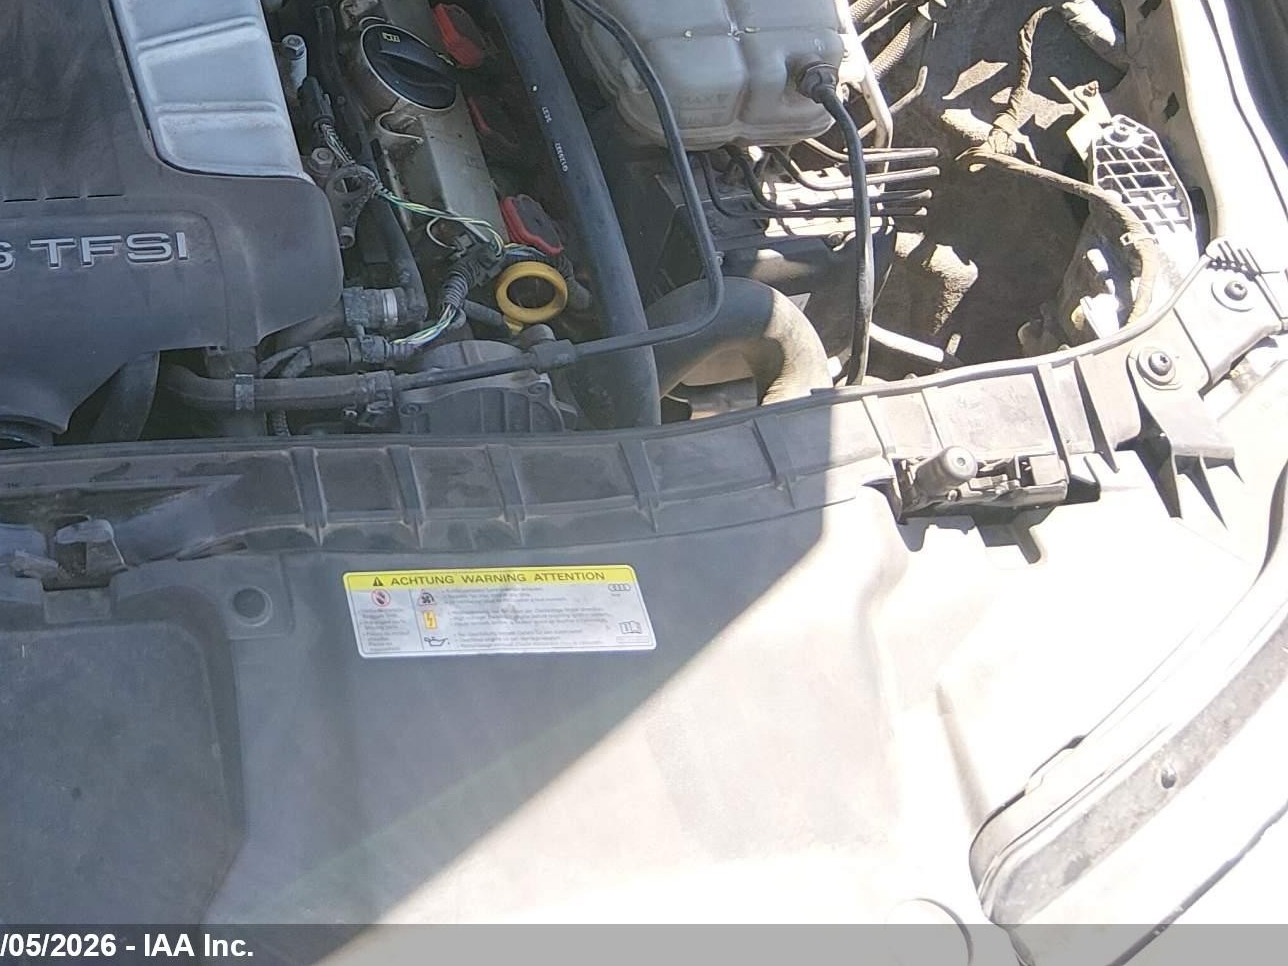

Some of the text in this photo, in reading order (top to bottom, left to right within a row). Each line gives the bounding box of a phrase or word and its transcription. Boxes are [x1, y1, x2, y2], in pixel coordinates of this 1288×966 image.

[27, 231, 191, 270] TFSI
[391, 571, 606, 586] ACHTUNG WARNING ATTENTION
